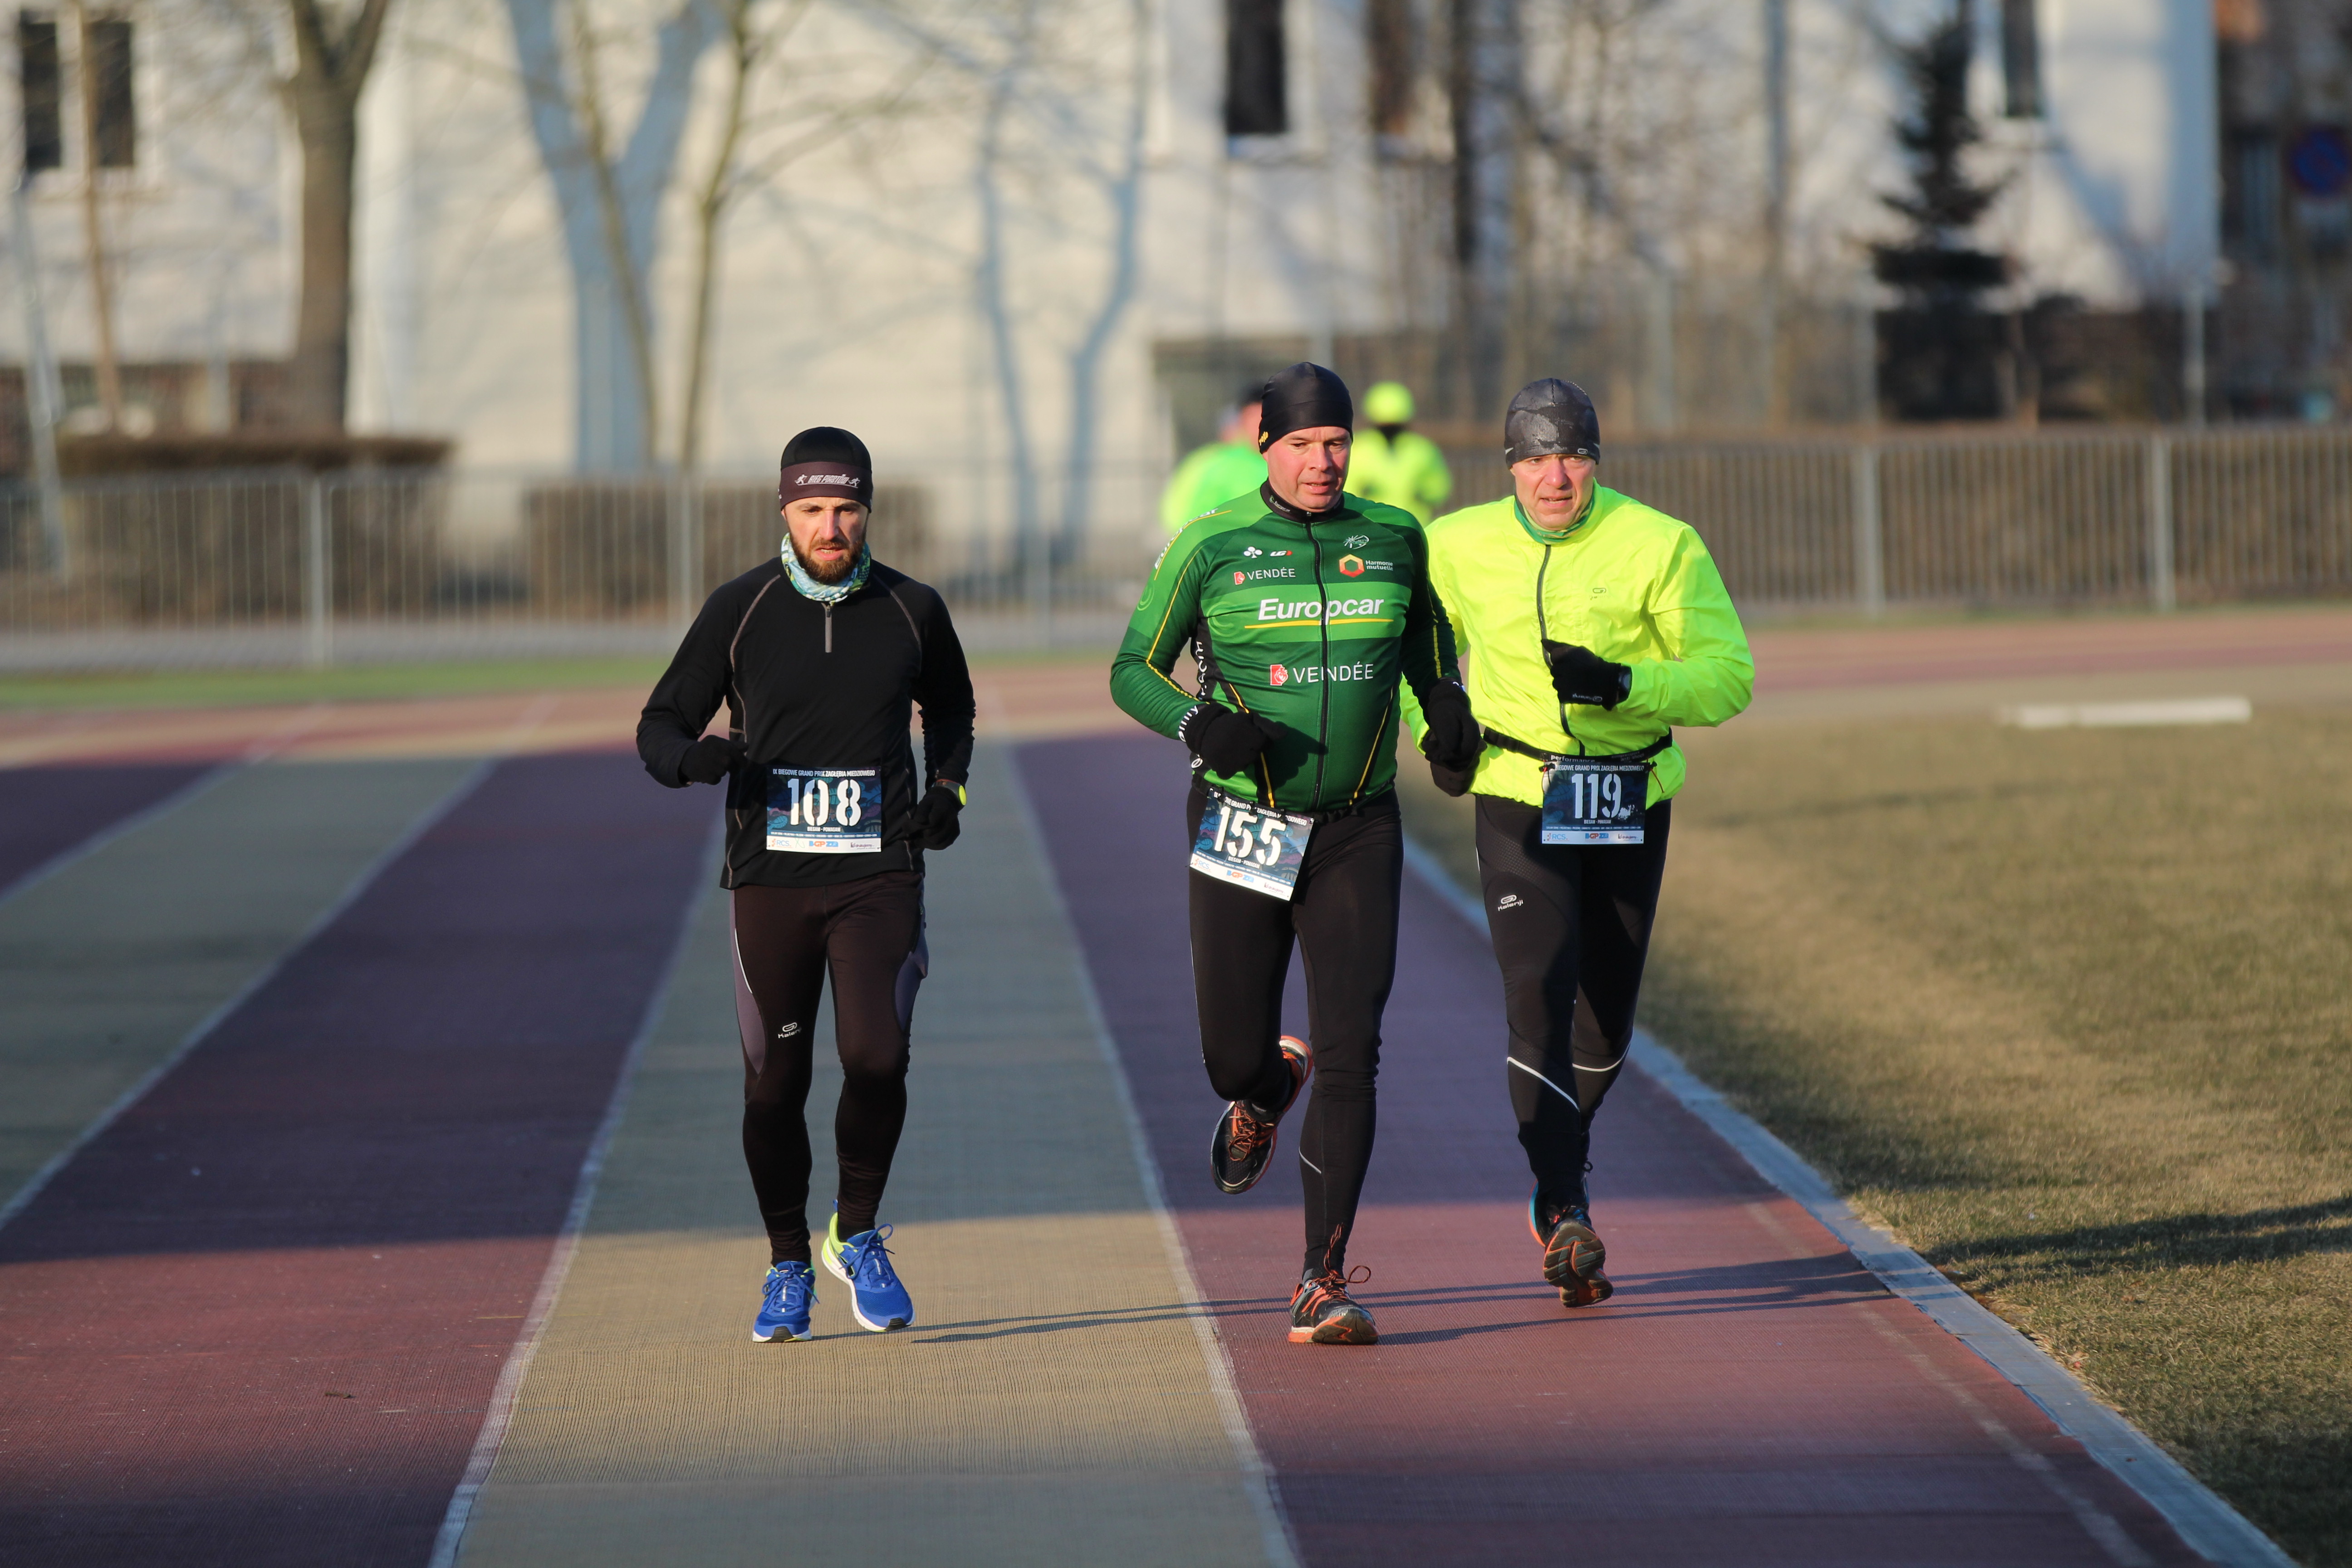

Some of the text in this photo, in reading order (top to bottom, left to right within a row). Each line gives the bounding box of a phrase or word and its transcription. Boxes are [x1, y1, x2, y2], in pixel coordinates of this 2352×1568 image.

[1247, 567, 1296, 580] VENDÉE
[1258, 598, 1384, 626] Europcar
[1293, 661, 1374, 683] VENDÉE
[787, 778, 862, 826] 108
[1231, 800, 1246, 809] GRAND
[1571, 773, 1622, 819] 119
[1214, 805, 1287, 866] 155
[1498, 899, 1524, 911] Kalenji
[778, 1027, 802, 1039] Kalen
